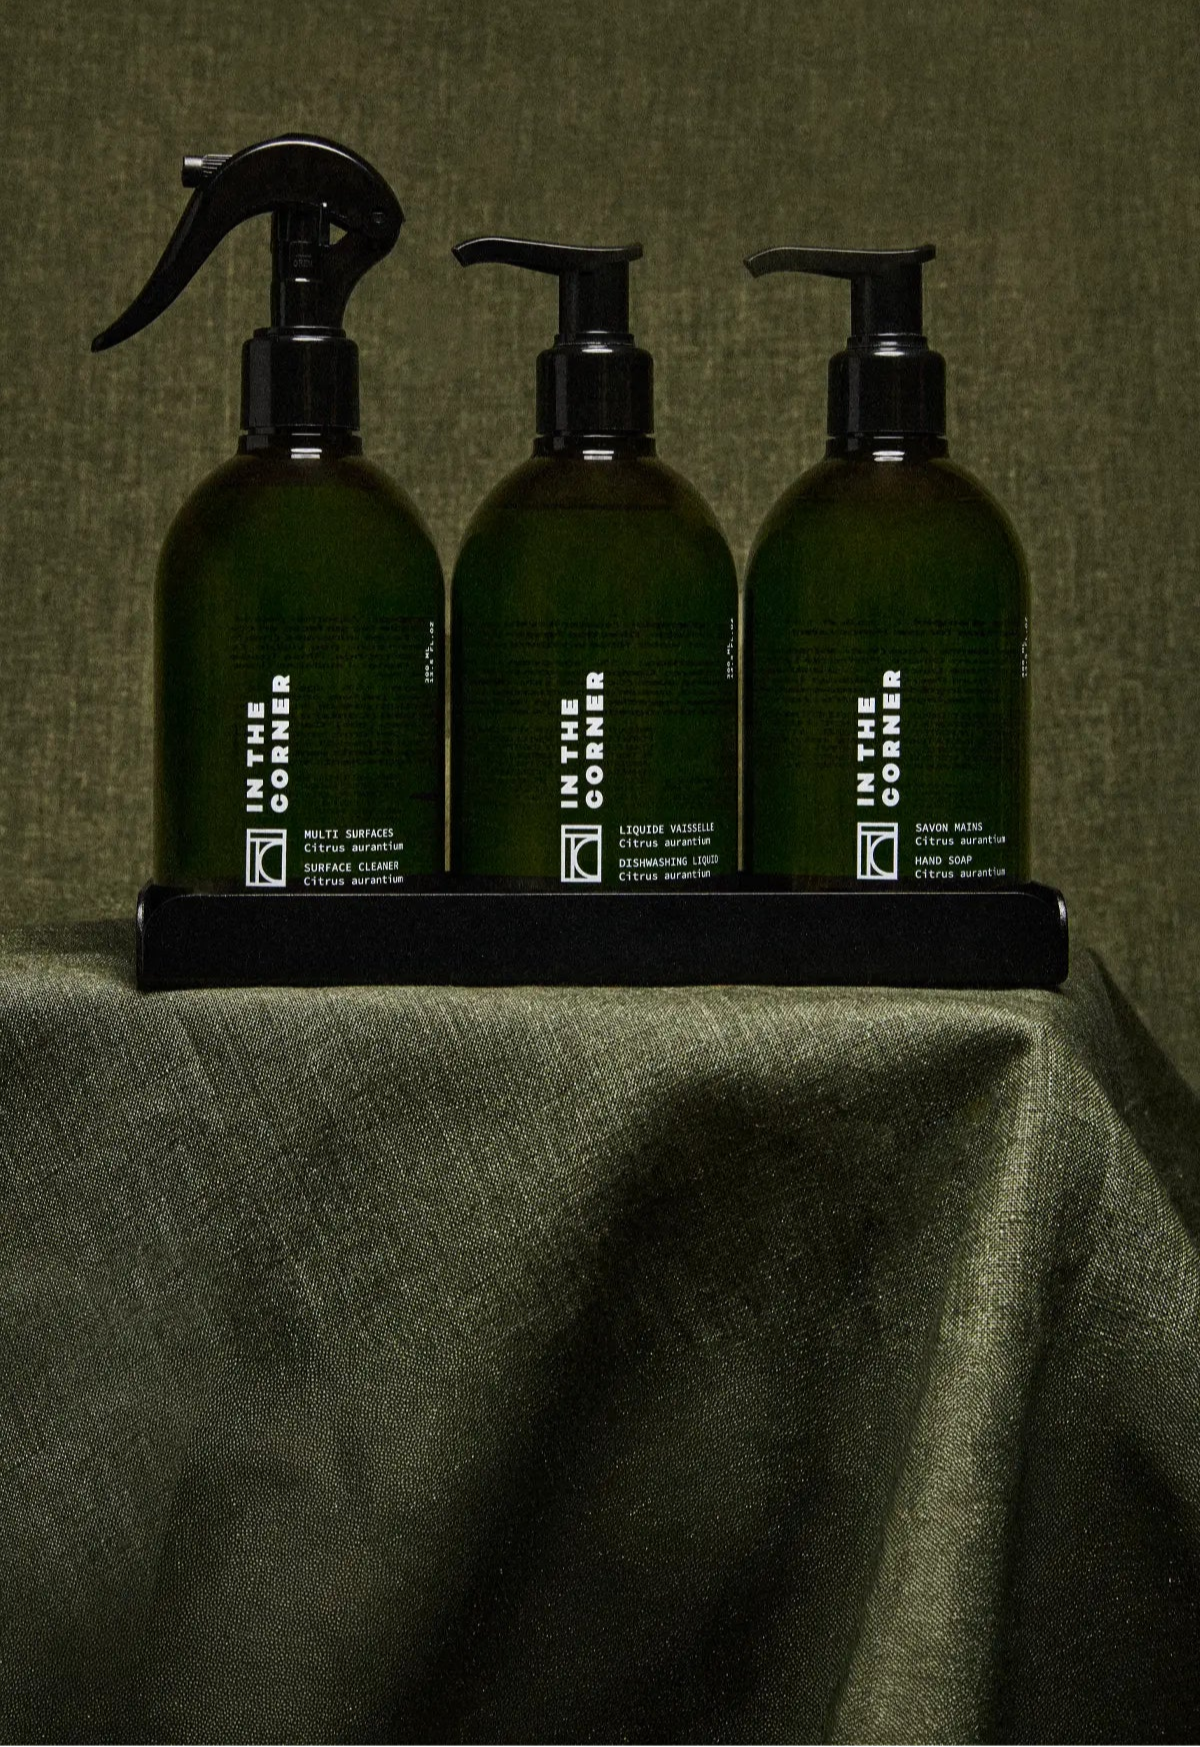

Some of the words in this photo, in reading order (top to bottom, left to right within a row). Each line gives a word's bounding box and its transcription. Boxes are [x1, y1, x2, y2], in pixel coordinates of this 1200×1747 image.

[246, 701, 265, 768] THE
[560, 698, 579, 765] THE
[856, 696, 876, 762] THE
[270, 674, 290, 813] CORNER
[585, 671, 604, 810] CORNER
[881, 669, 901, 807] CORNER
[246, 778, 264, 813] IN
[560, 774, 579, 809] IN
[856, 772, 875, 807] IN
[304, 829, 339, 840] MULTI
[345, 828, 394, 839] SURFACES
[619, 825, 665, 837] LIQUIDE
[670, 822, 715, 834] VAISSELLE
[915, 823, 949, 833] SAVON
[954, 822, 983, 832] MAINS
[304, 842, 346, 853] Citrus
[351, 841, 404, 853] aurantium
[618, 838, 659, 849] Citrus
[915, 835, 955, 846] Citrus
[304, 862, 352, 873] SURFACE
[358, 861, 399, 872] CLEANER
[618, 857, 688, 868] DISHWASHING
[692, 854, 719, 867] LIQUID
[914, 855, 943, 866] HAND
[948, 855, 973, 865] SOAP
[303, 876, 345, 887] Citrus
[351, 874, 404, 886] aurantium
[618, 870, 658, 882] Citrus
[914, 868, 954, 879] Citrus
